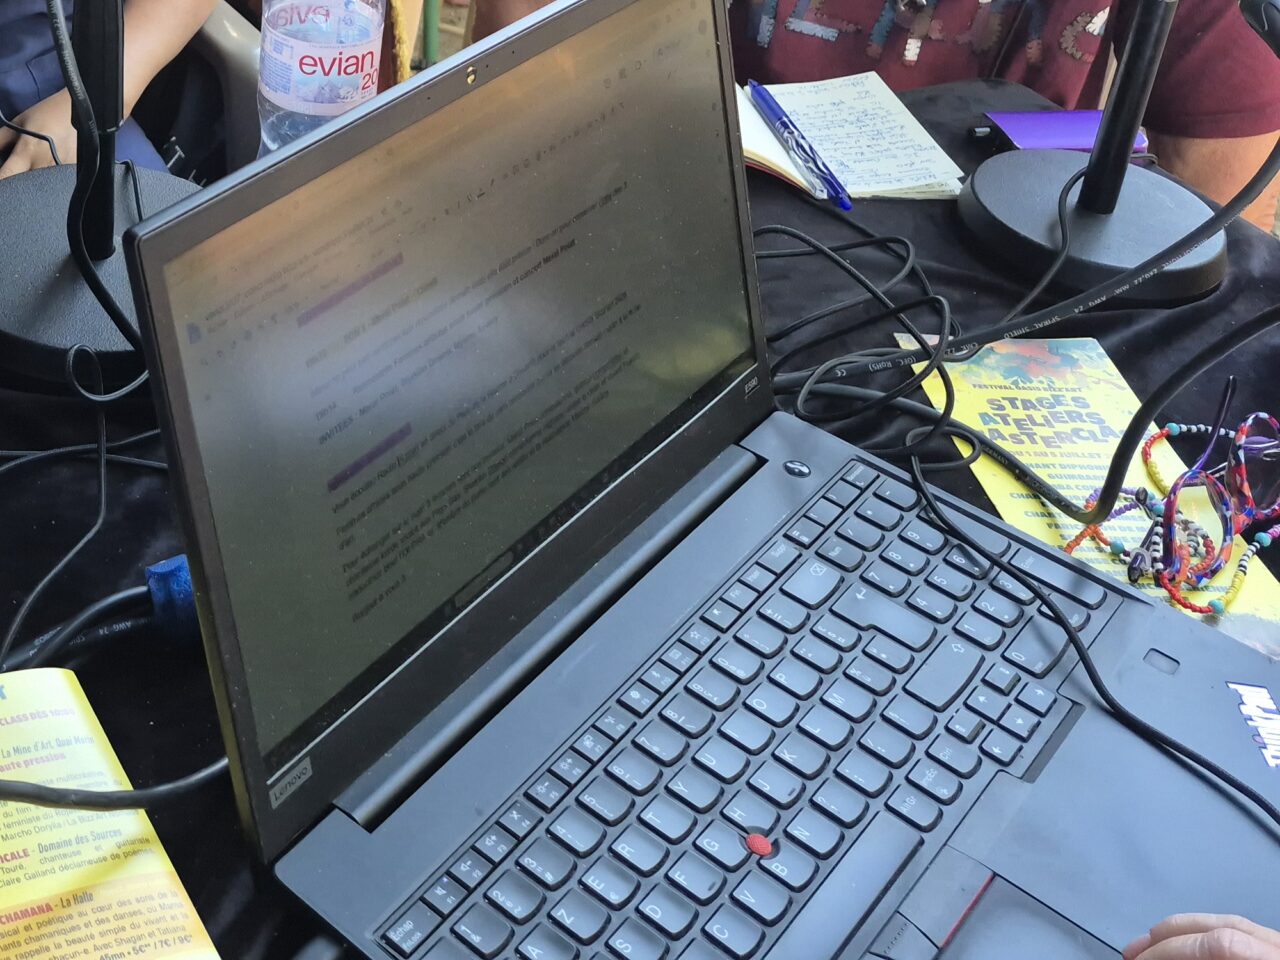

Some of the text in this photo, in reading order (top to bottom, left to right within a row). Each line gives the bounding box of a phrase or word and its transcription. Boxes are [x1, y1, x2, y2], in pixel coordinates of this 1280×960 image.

[298, 50, 374, 77] evian
[986, 394, 1091, 412] STAGES
[776, 672, 788, 684] P
[752, 698, 767, 709] O
[829, 692, 845, 708] M
[700, 752, 717, 766] U
[273, 766, 308, 802] Lenovo
[673, 780, 689, 794] Y
[2, 810, 13, 818] du
[15, 806, 31, 815] film
[645, 811, 661, 824] T
[729, 807, 747, 821] H
[37, 838, 72, 853] Domaine
[618, 842, 635, 858] R
[702, 838, 720, 852] G
[38, 850, 81, 864] chanteuse
[587, 875, 605, 890] E
[674, 871, 688, 886] F
[59, 897, 71, 908] La
[740, 889, 757, 904] V
[23, 923, 32, 932] et
[35, 913, 73, 929] poétique
[76, 910, 88, 918] au
[115, 899, 132, 907] des
[557, 908, 575, 924] Z
[645, 904, 662, 919] D
[22, 924, 80, 945] chamaniques
[83, 919, 92, 928] et
[94, 916, 110, 925] des
[712, 923, 729, 939] C
[14, 945, 50, 960] rappelle
[52, 941, 62, 949] la
[64, 932, 95, 946] beauté
[98, 924, 126, 937] simple
[129, 920, 141, 929] du
[92, 941, 113, 952] Avec
[113, 933, 146, 946] Shagan
[147, 929, 156, 938] et
[527, 946, 544, 959] A
